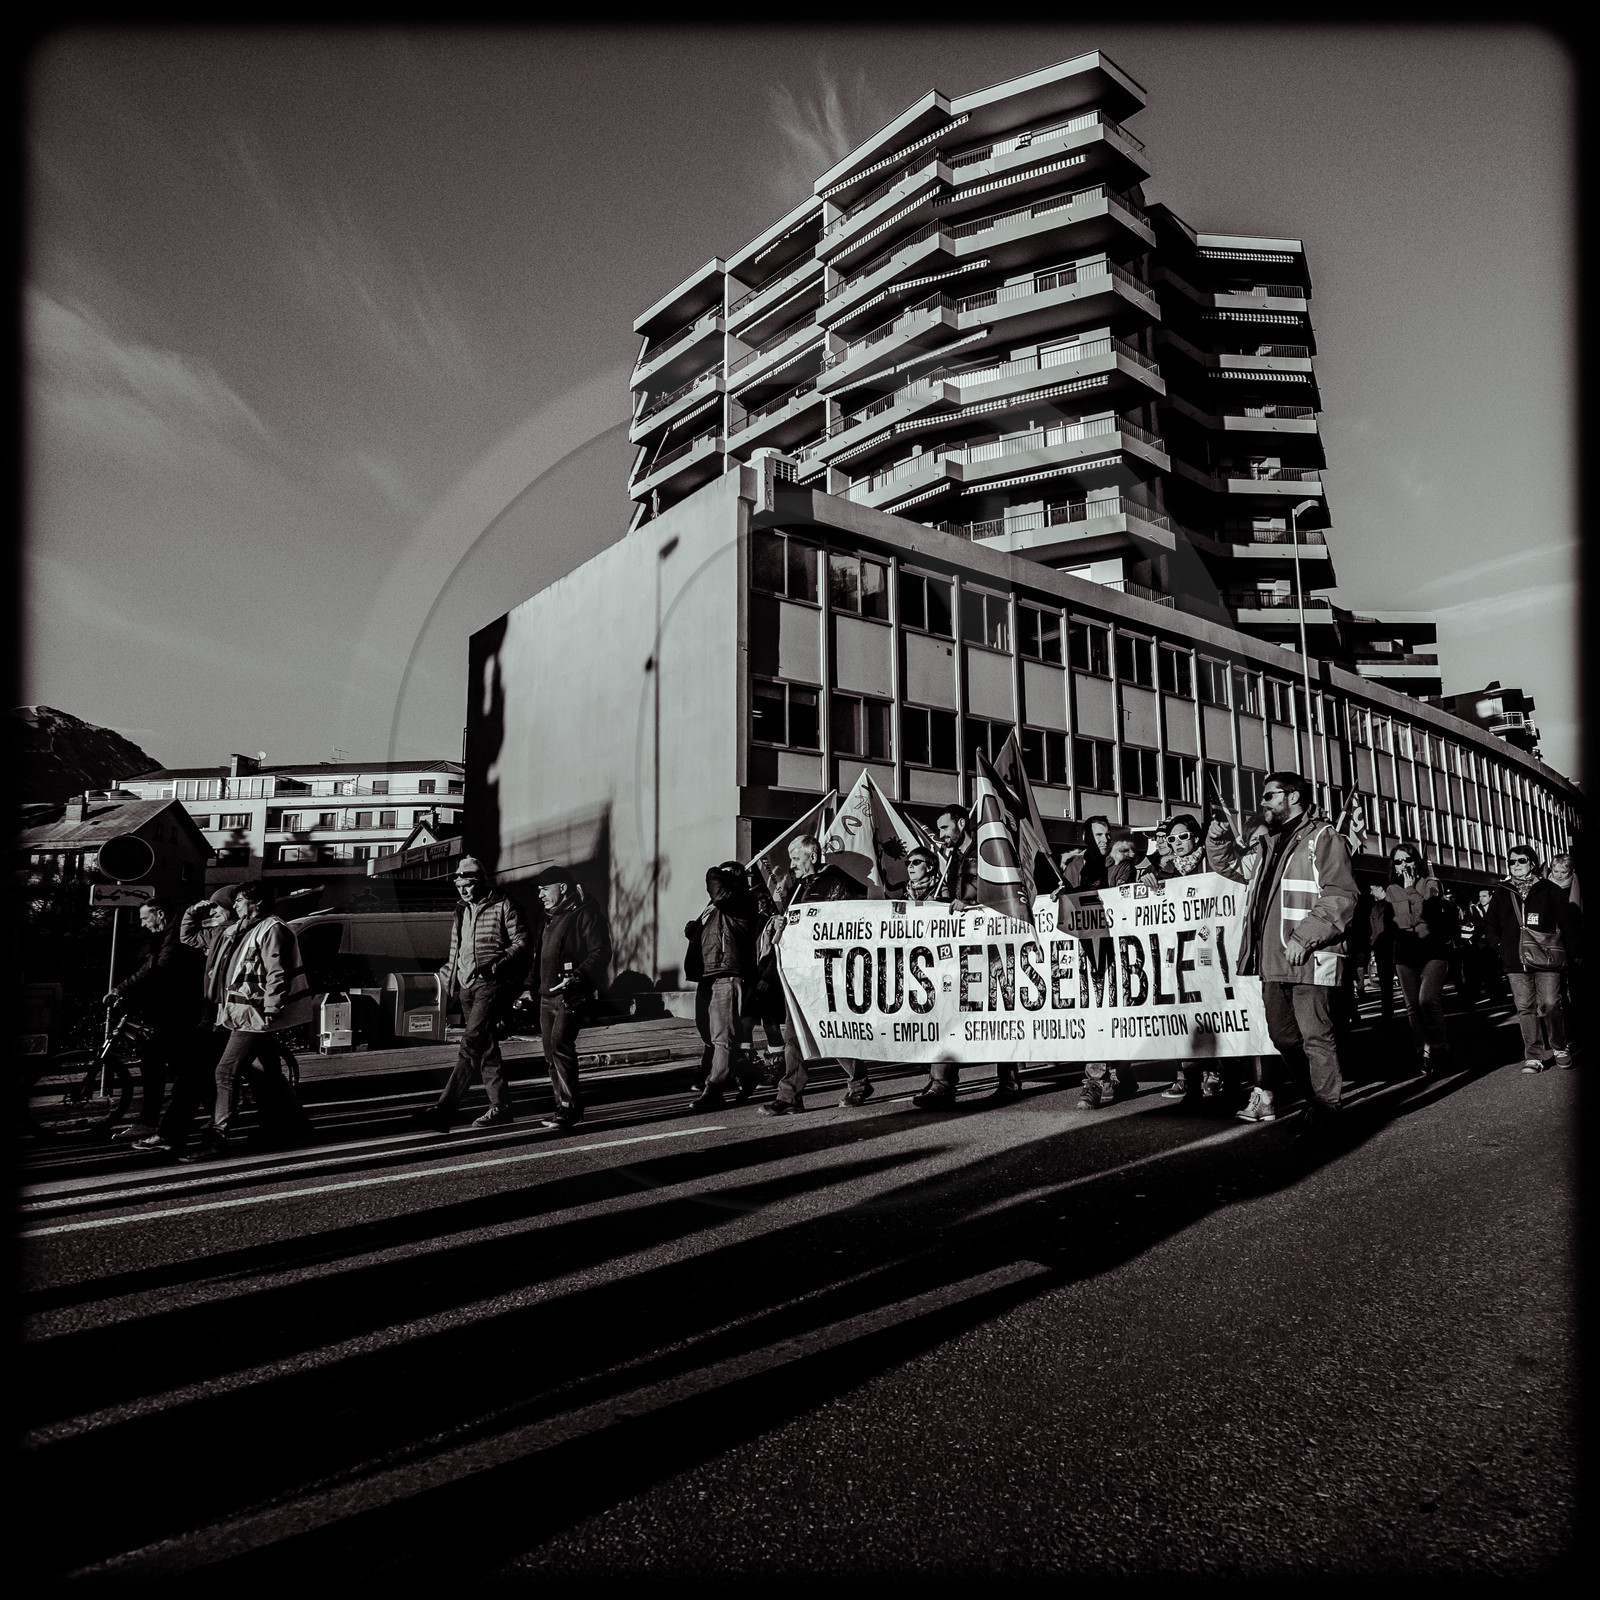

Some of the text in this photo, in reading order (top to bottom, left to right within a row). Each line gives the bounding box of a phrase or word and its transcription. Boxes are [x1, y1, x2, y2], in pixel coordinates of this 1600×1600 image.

[813, 917, 873, 941] SALARIÉS
[880, 913, 966, 939] PUBLIC/PRIVÉ
[987, 909, 1054, 936] RETRAIÉS
[1068, 908, 1114, 932] JEUNES
[1135, 900, 1176, 926] PRIVÉS
[1183, 895, 1236, 922] D'EMPLOI
[814, 945, 936, 1014] TOUS
[958, 930, 1203, 1012] ENSEMBLE
[819, 1020, 874, 1042] SALAIRES
[893, 1022, 940, 1042] EMPLOI
[965, 1020, 1025, 1041] SERVICES
[1033, 1018, 1086, 1040] PUBLICS
[1111, 1014, 1189, 1039] PROTECTION
[1195, 1009, 1250, 1035] SOCIALE
